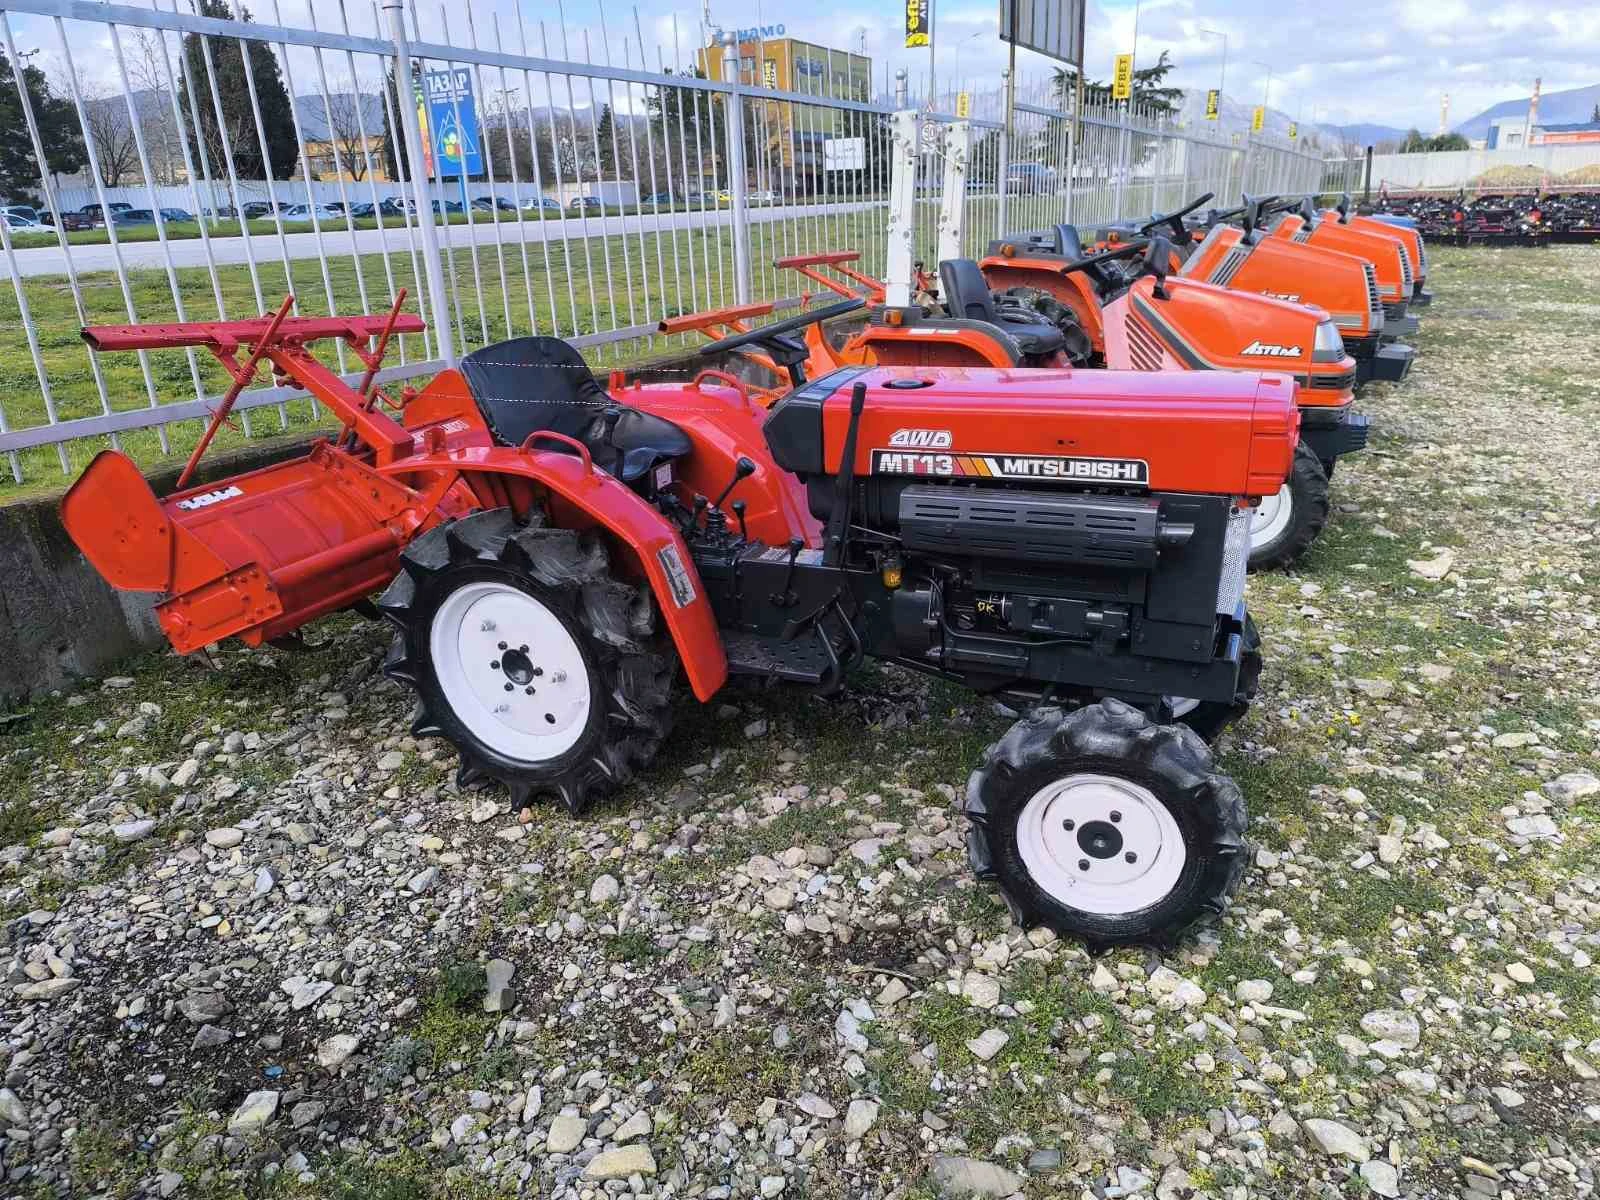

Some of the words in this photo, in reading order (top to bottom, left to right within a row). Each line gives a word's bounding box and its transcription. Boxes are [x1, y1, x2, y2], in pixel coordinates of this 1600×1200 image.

[1117, 58, 1128, 96] EFBET
[878, 452, 954, 474] MT13
[1003, 457, 1139, 480] MITSUBISHI
